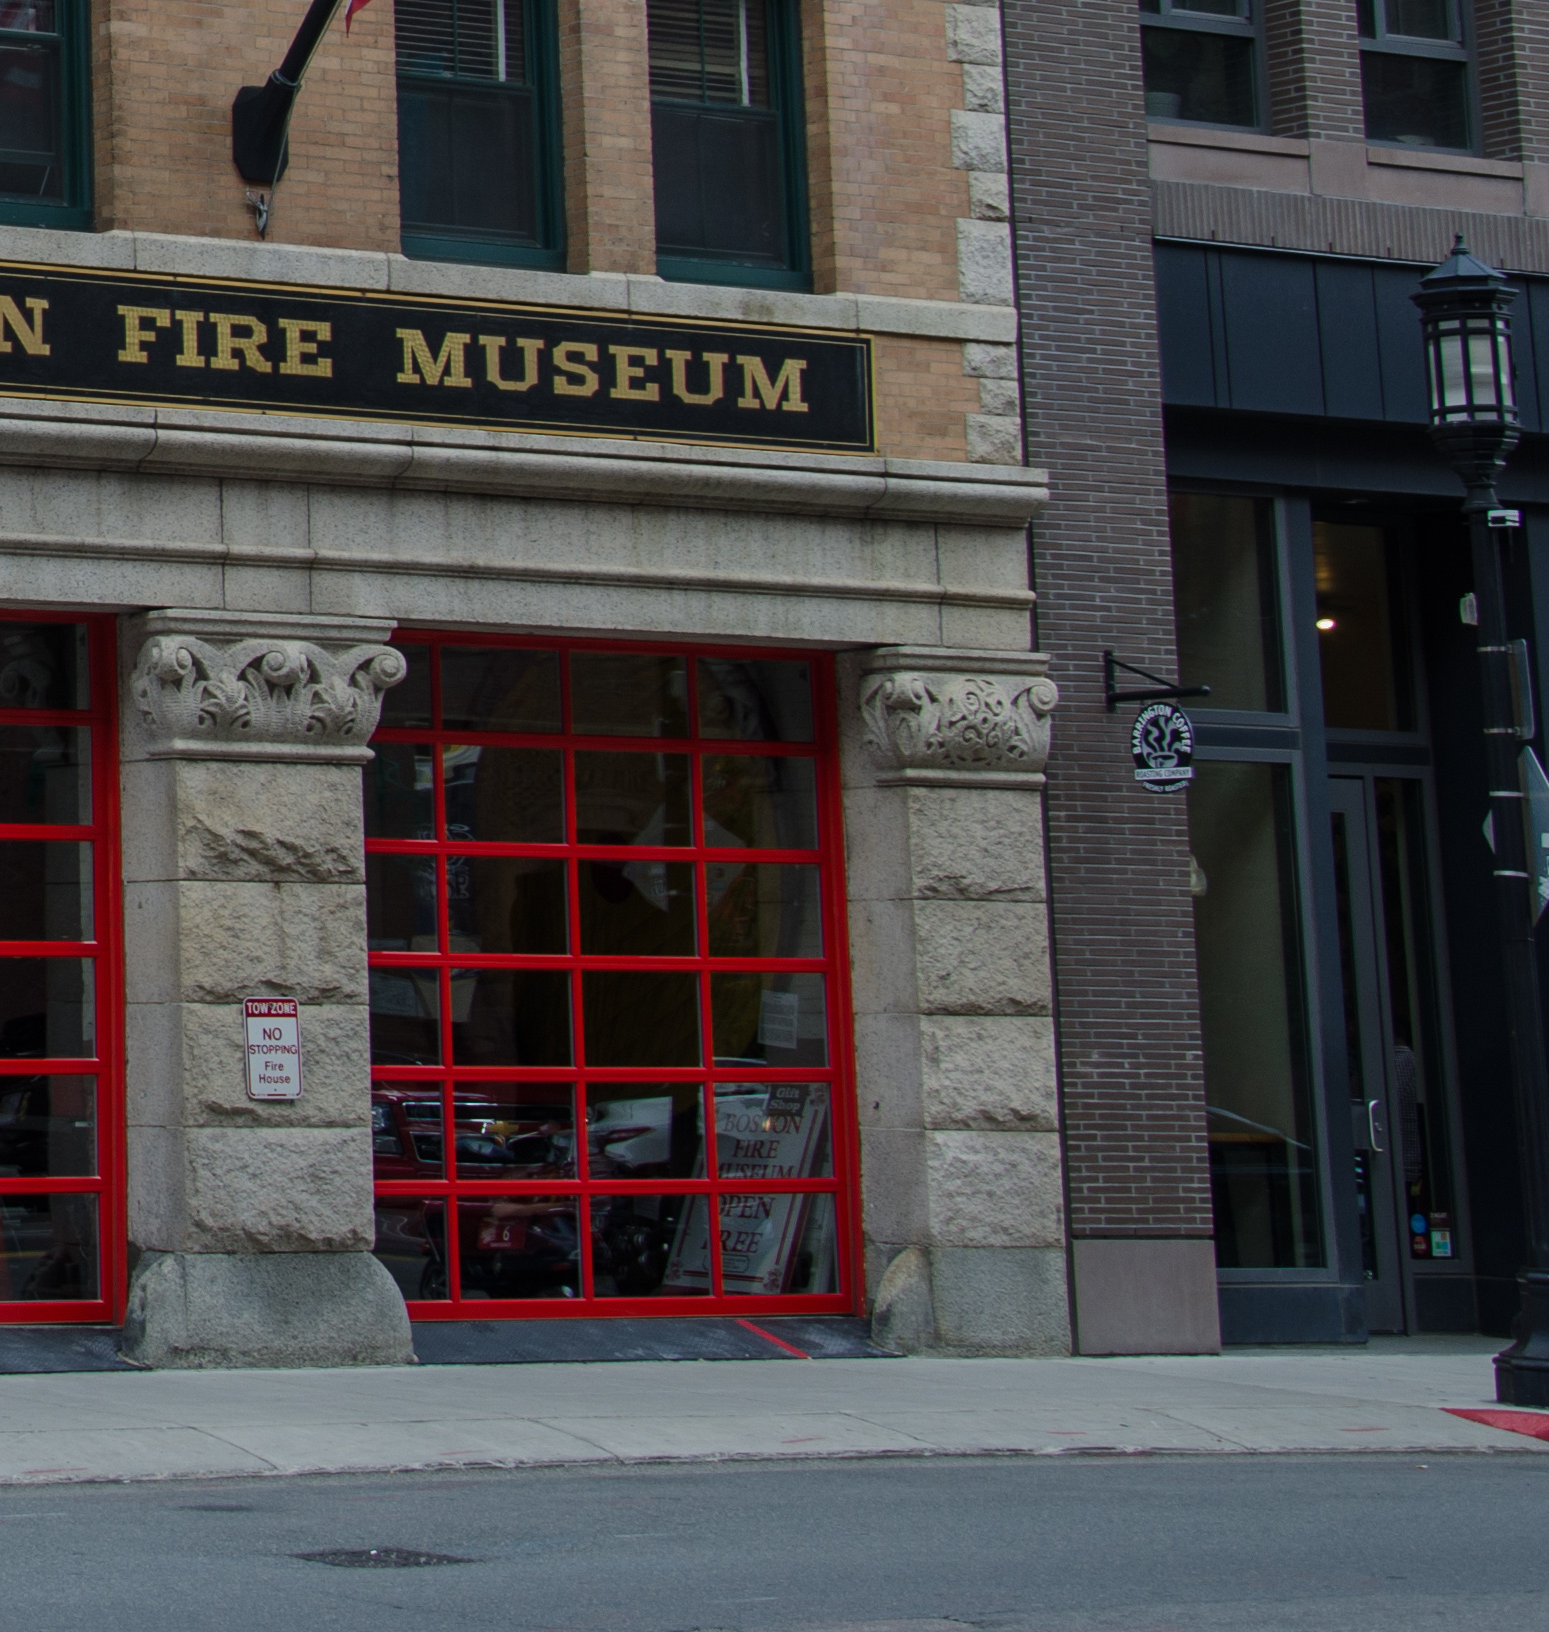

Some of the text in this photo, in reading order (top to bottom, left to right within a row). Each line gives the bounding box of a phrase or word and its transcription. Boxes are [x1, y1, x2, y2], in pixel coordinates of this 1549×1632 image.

[117, 305, 333, 378] FIRE
[395, 327, 809, 413] MUSEUM
[1132, 704, 1192, 754] BARRINGTON COFFEE
[246, 1002, 296, 1015] TOW ZONE
[263, 1027, 282, 1041] NO
[249, 1044, 297, 1055] STOPPING
[264, 1061, 284, 1071] Fire
[258, 1074, 290, 1084] House
[776, 1087, 800, 1098] Gift
[769, 1099, 801, 1113] Shop
[732, 1138, 780, 1159] FIRE
[700, 1229, 763, 1254] REE
